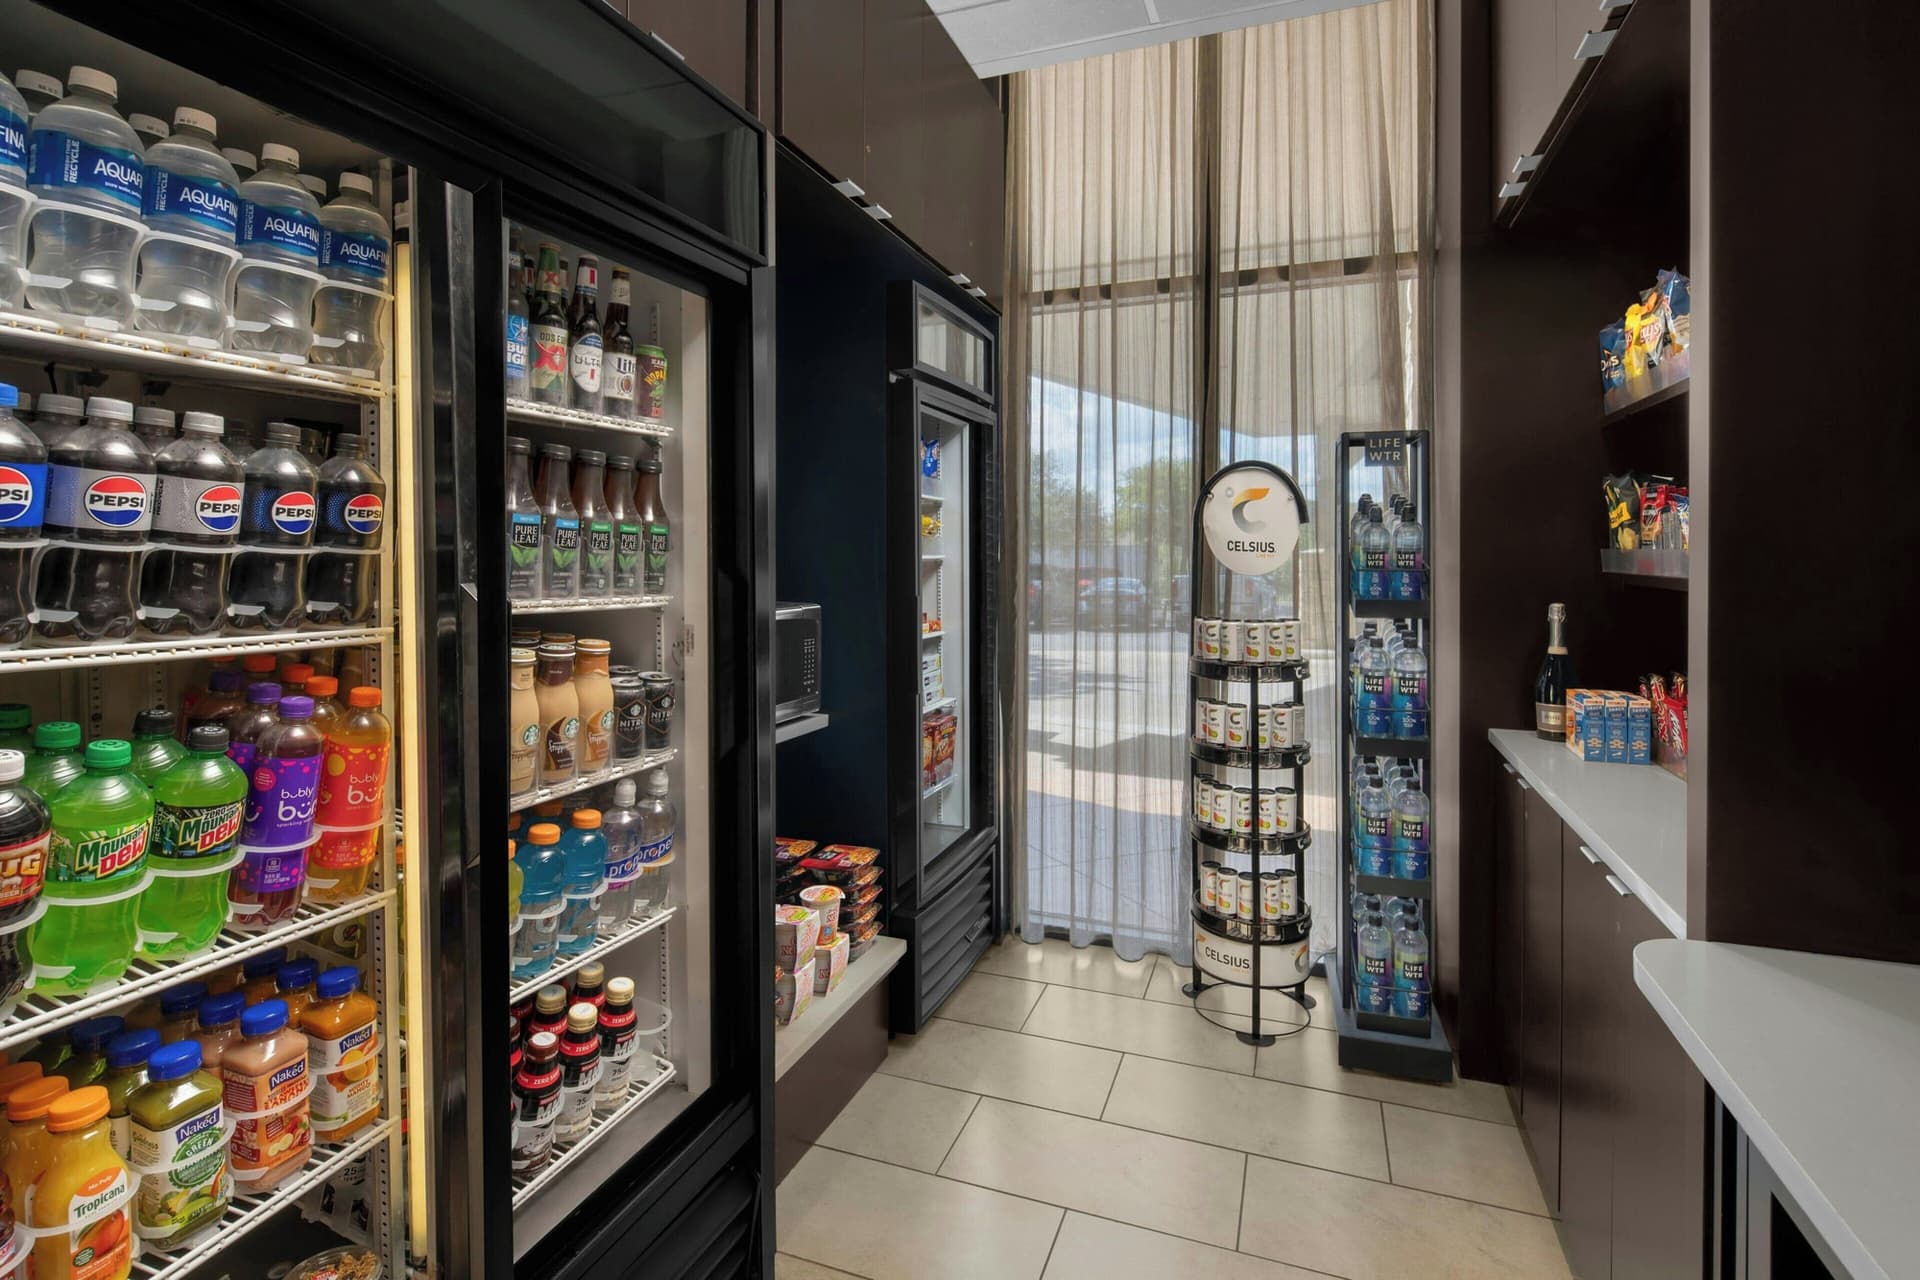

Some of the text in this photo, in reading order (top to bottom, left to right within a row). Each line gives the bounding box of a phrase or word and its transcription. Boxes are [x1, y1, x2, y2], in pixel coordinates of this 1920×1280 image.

[1369, 438, 1401, 449] LIFE
[1369, 451, 1401, 461] WTR
[89, 494, 144, 508] PEPSI
[200, 502, 241, 514] PEPSI
[275, 506, 314, 518] PEPSI
[347, 508, 382, 519] PEPSI
[514, 525, 538, 535] PURE
[557, 530, 577, 539] PURE
[592, 532, 609, 541] PURE
[1227, 540, 1275, 553] CELSIUS
[350, 774, 378, 784] bubly
[281, 786, 314, 799] bubly
[1367, 819, 1386, 827] LIFE
[1403, 823, 1422, 831] LIFE
[1367, 826, 1386, 834] WTR
[1204, 945, 1250, 970] CELSIUS
[1366, 966, 1385, 974] WTR
[1404, 964, 1423, 972] LIFE
[1404, 971, 1423, 979] WTR
[342, 1028, 371, 1051] Naked
[271, 1061, 305, 1088] Naked
[180, 1111, 218, 1141] Naked
[73, 1184, 125, 1218] Tropicana
